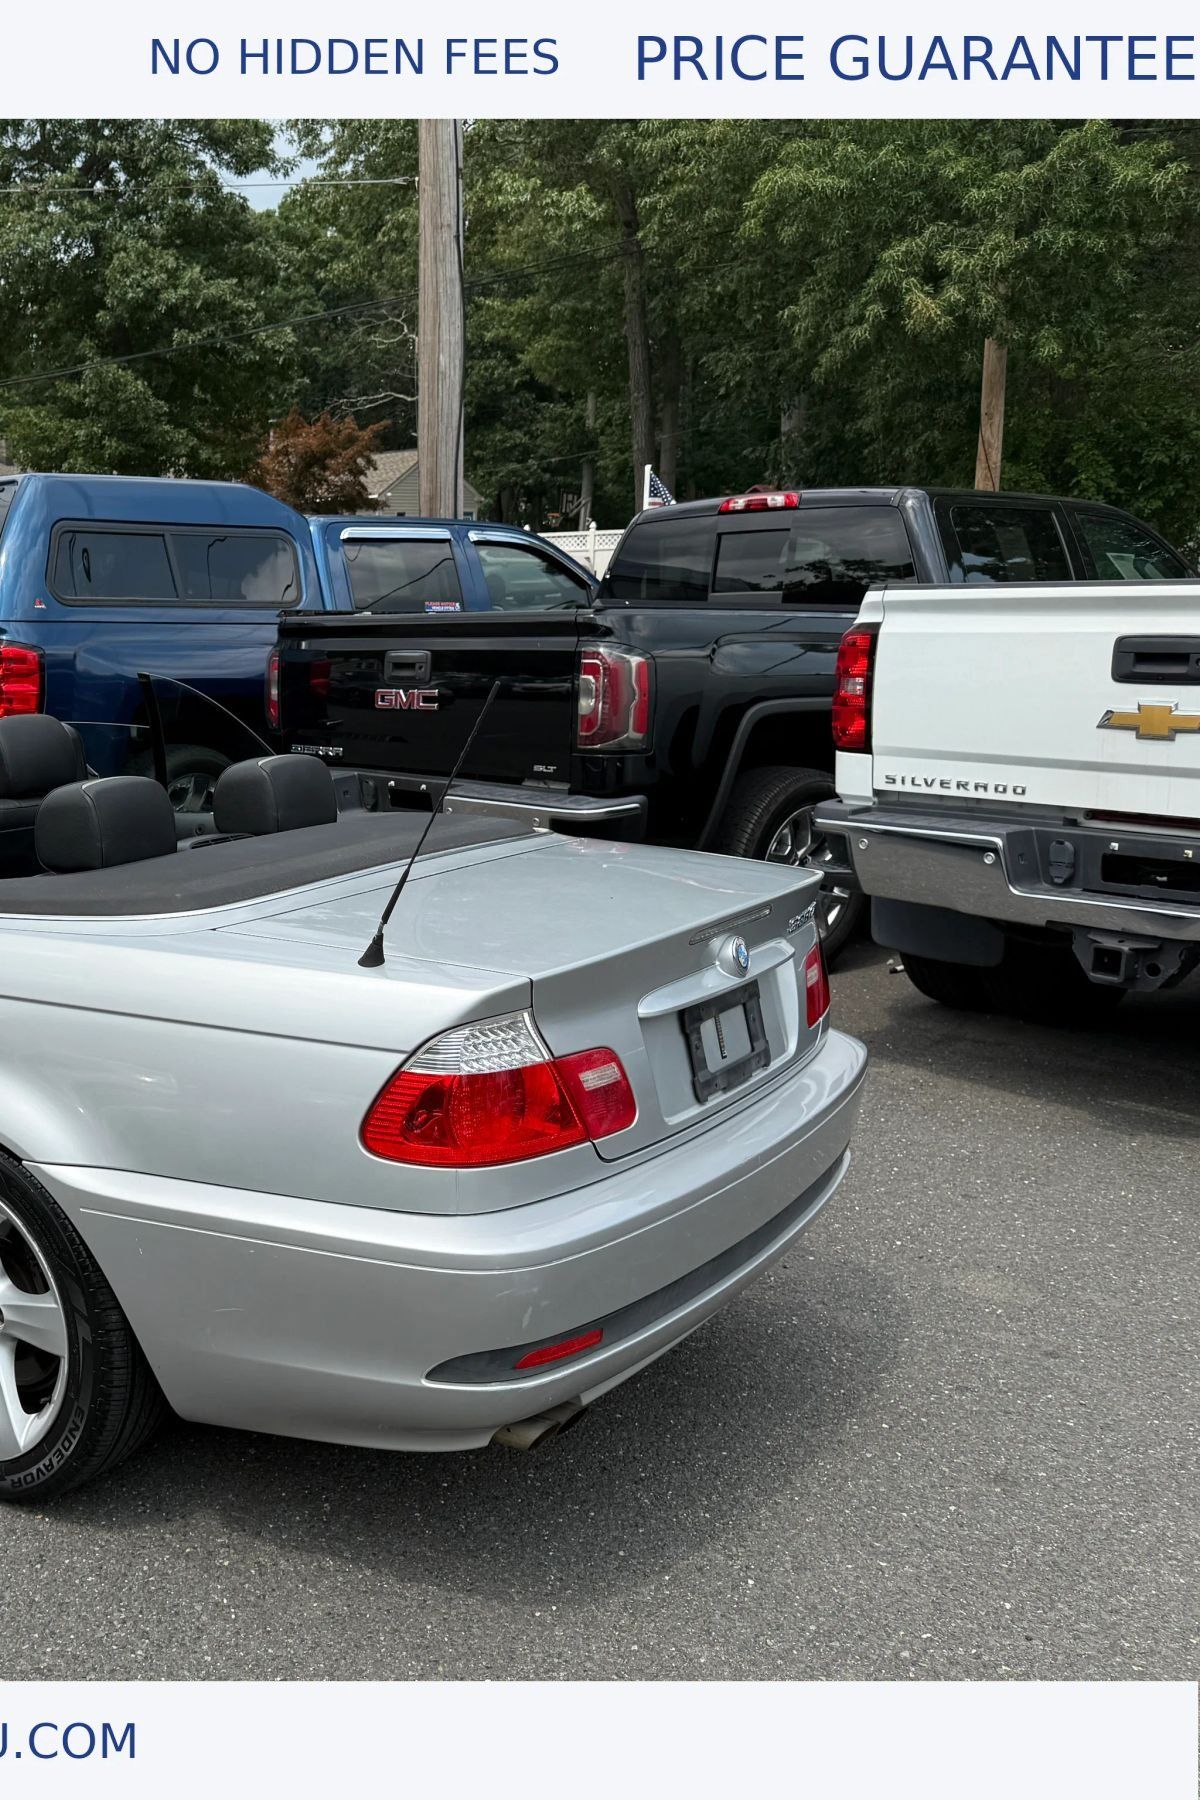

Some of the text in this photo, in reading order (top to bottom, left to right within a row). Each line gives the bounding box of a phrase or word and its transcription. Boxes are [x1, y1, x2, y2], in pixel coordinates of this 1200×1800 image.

[374, 688, 440, 711] GMC
[884, 774, 1028, 796] SILVERADO
[10, 1405, 86, 1489] ENDEAVOR
